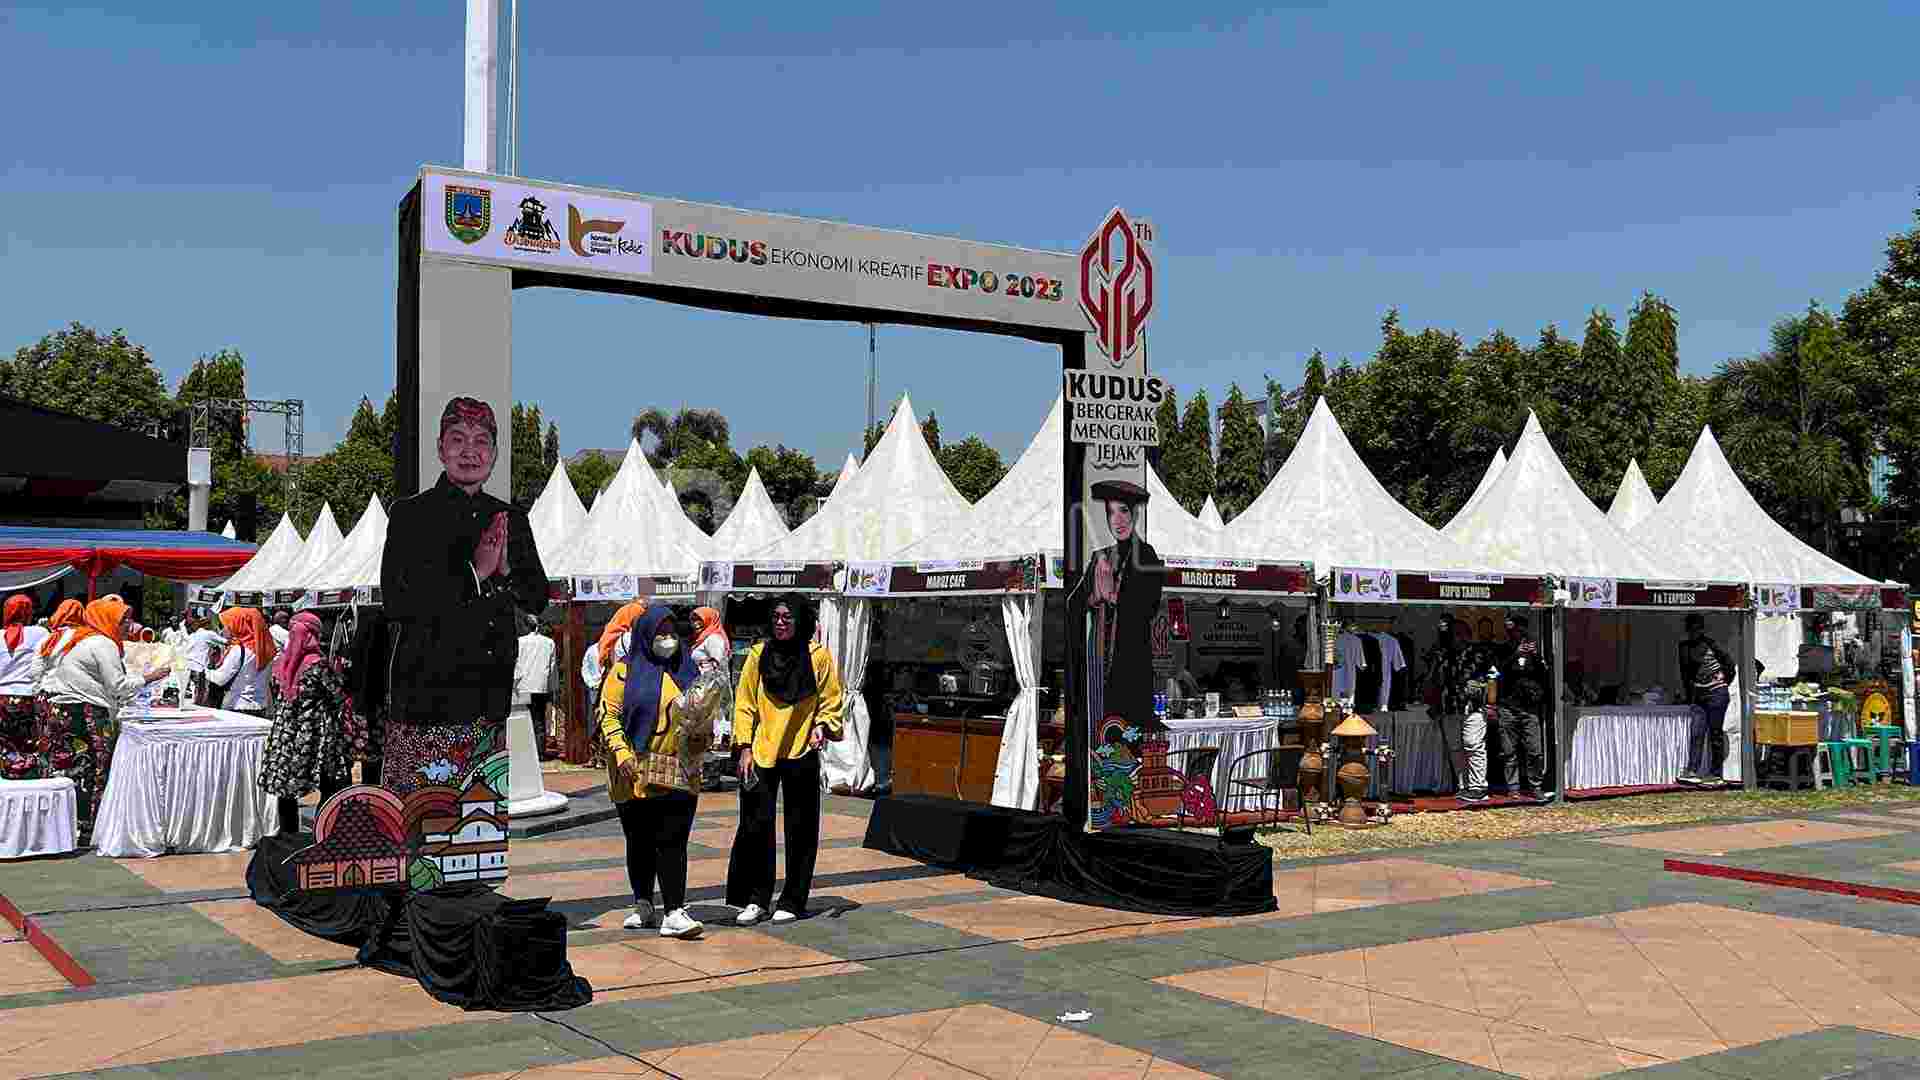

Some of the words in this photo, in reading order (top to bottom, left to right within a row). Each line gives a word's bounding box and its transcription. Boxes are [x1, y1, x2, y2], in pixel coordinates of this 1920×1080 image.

[662, 229, 768, 265] KUDUS
[771, 247, 853, 273] EKONOMI
[857, 259, 924, 281] KREATIF
[927, 263, 999, 293] EXPO
[1005, 273, 1063, 302] 2023
[1069, 373, 1163, 403] KUDUS
[1076, 402, 1155, 421] BERGERAK
[1073, 423, 1157, 442] MENGUKIR
[1097, 444, 1138, 461] JEJAK
[927, 574, 948, 588] MAROZ
[949, 574, 967, 588] CAFE
[1181, 571, 1213, 586] MAROZ
[1215, 572, 1238, 586] CAFE
